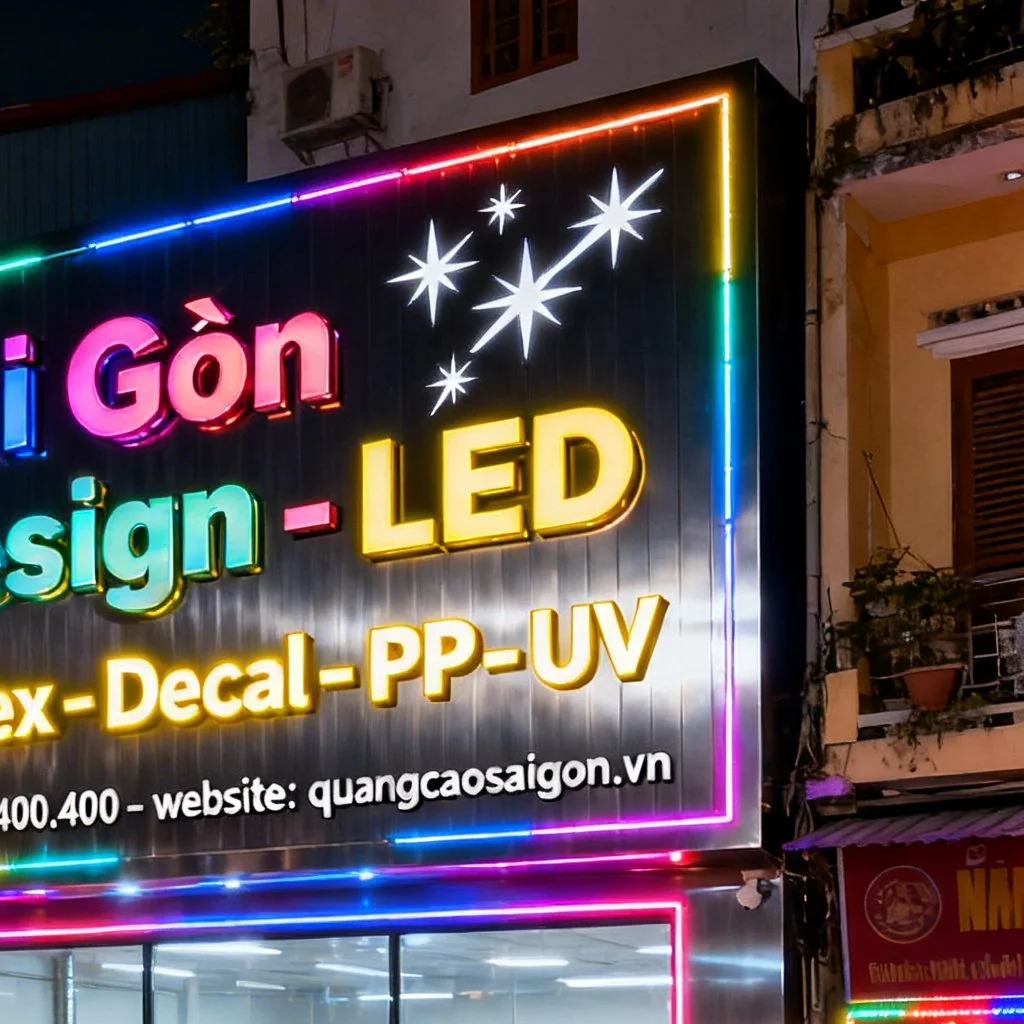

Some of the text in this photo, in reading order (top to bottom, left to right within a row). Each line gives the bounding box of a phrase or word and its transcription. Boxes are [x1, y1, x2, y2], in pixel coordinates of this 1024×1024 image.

[66, 297, 340, 447] Gòn
[360, 406, 647, 562] LED
[152, 776, 297, 820] website:
[307, 750, 673, 818] quangcaosaigon.vn
